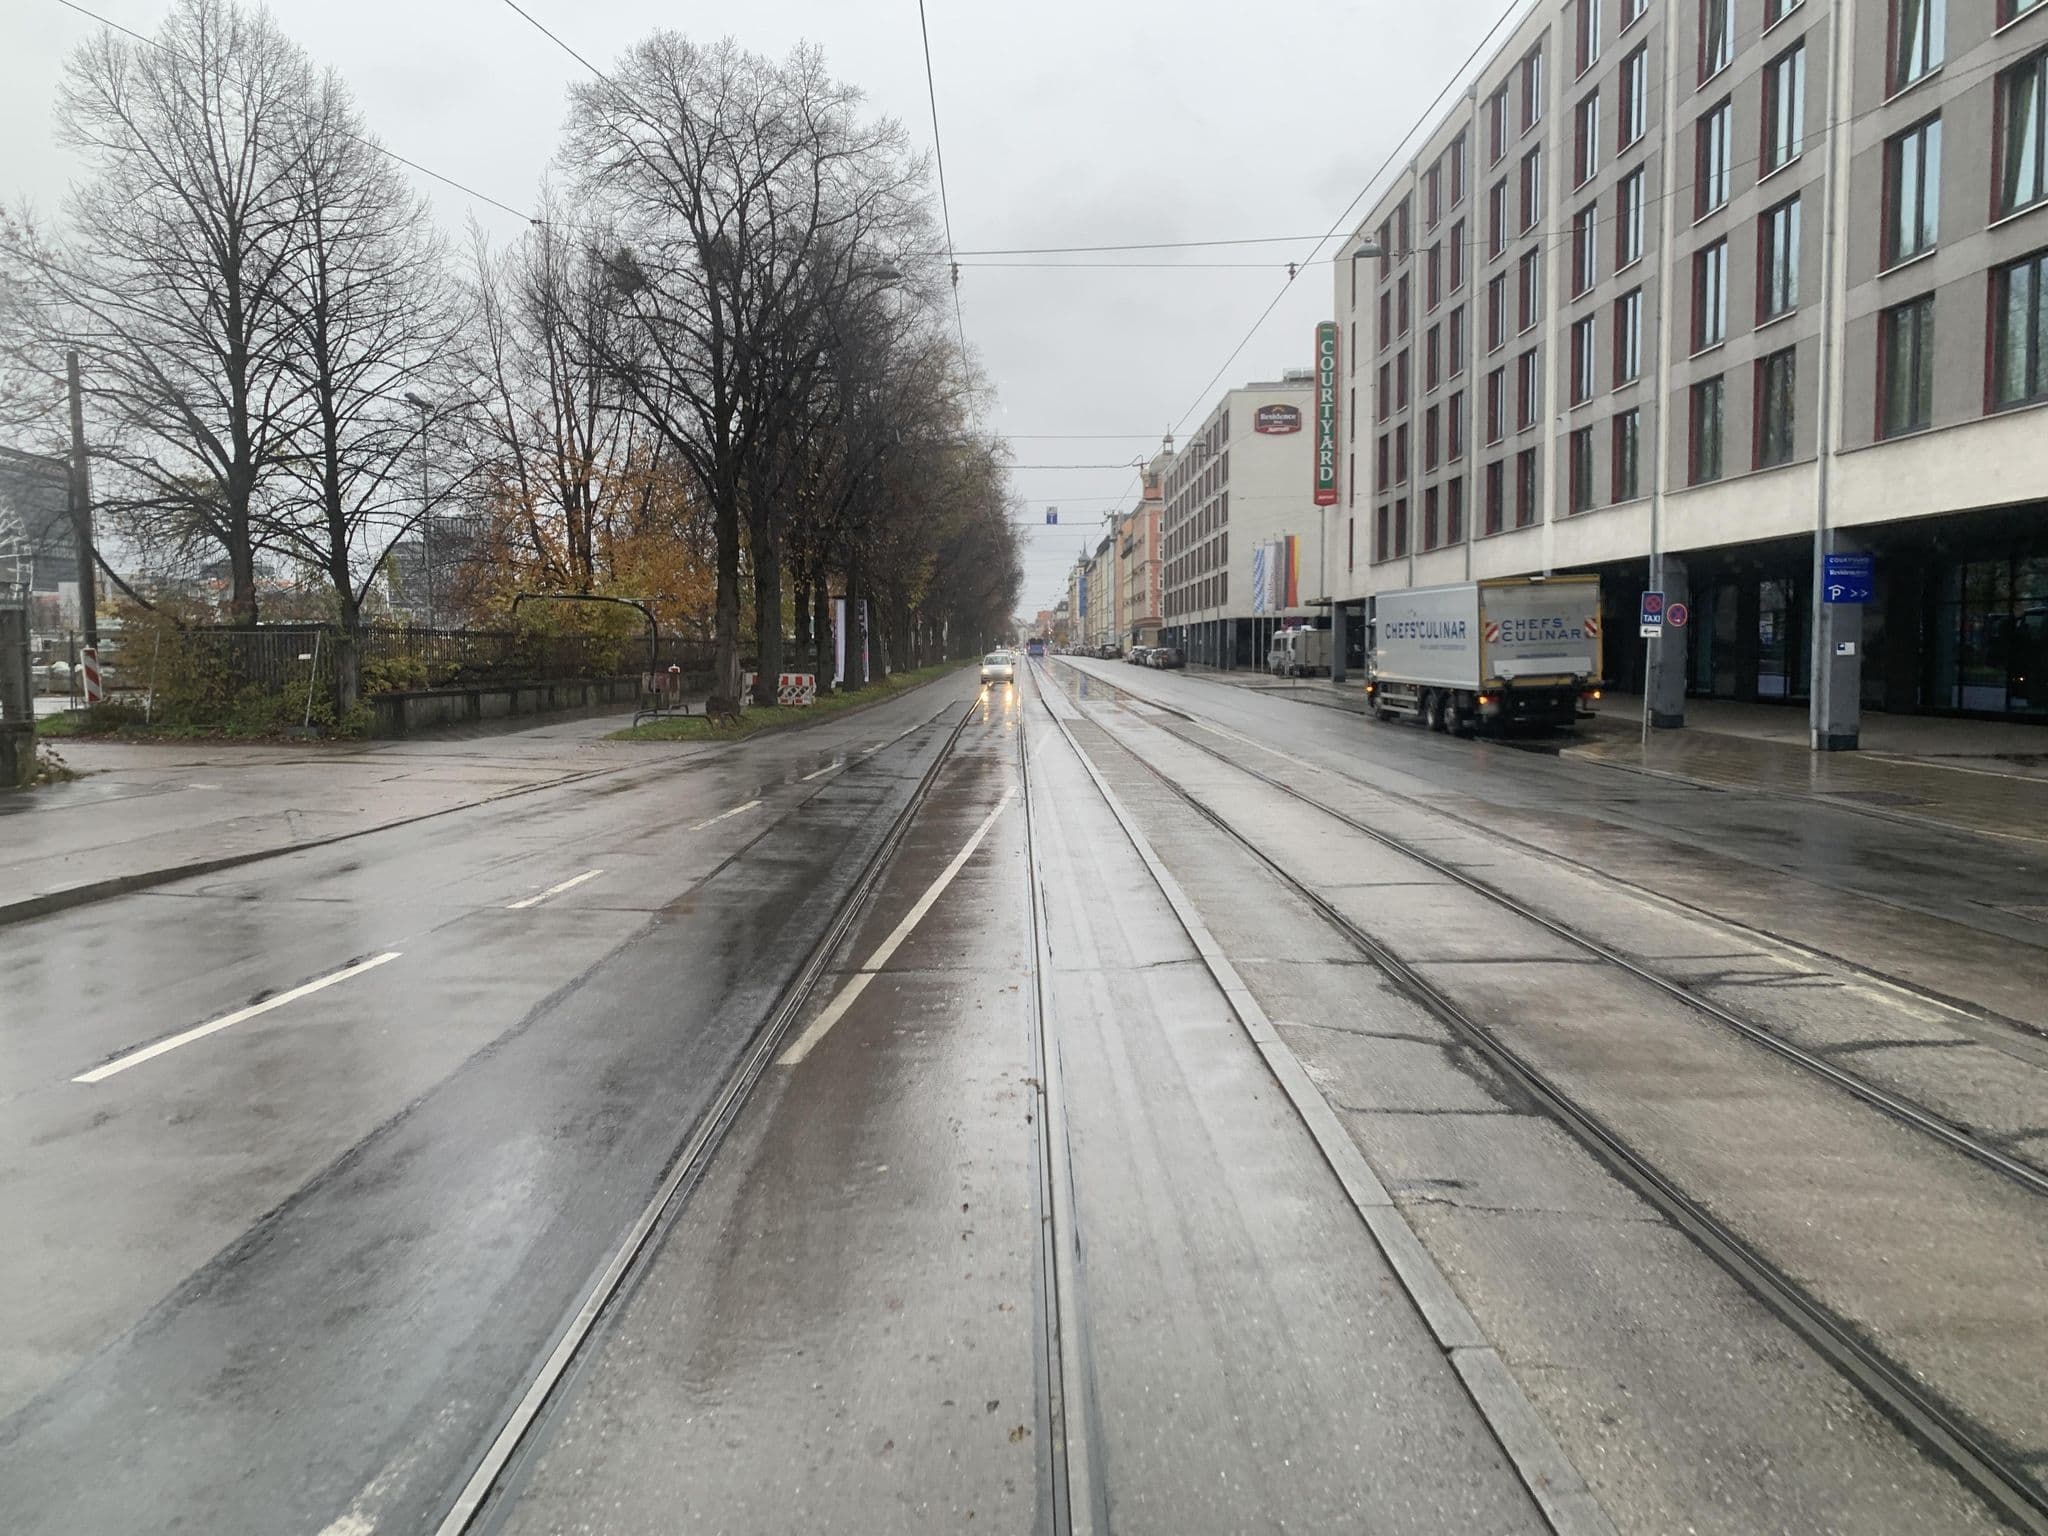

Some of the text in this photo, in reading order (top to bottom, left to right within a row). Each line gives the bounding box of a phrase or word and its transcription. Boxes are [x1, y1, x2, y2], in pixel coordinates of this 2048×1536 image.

[1319, 339, 1335, 482] COURTYARD
[1502, 618, 1563, 631] CHEFS
[1642, 614, 1661, 623] TAXI
[1418, 620, 1466, 640] CULINAR
[1502, 628, 1583, 642] CULINAR
